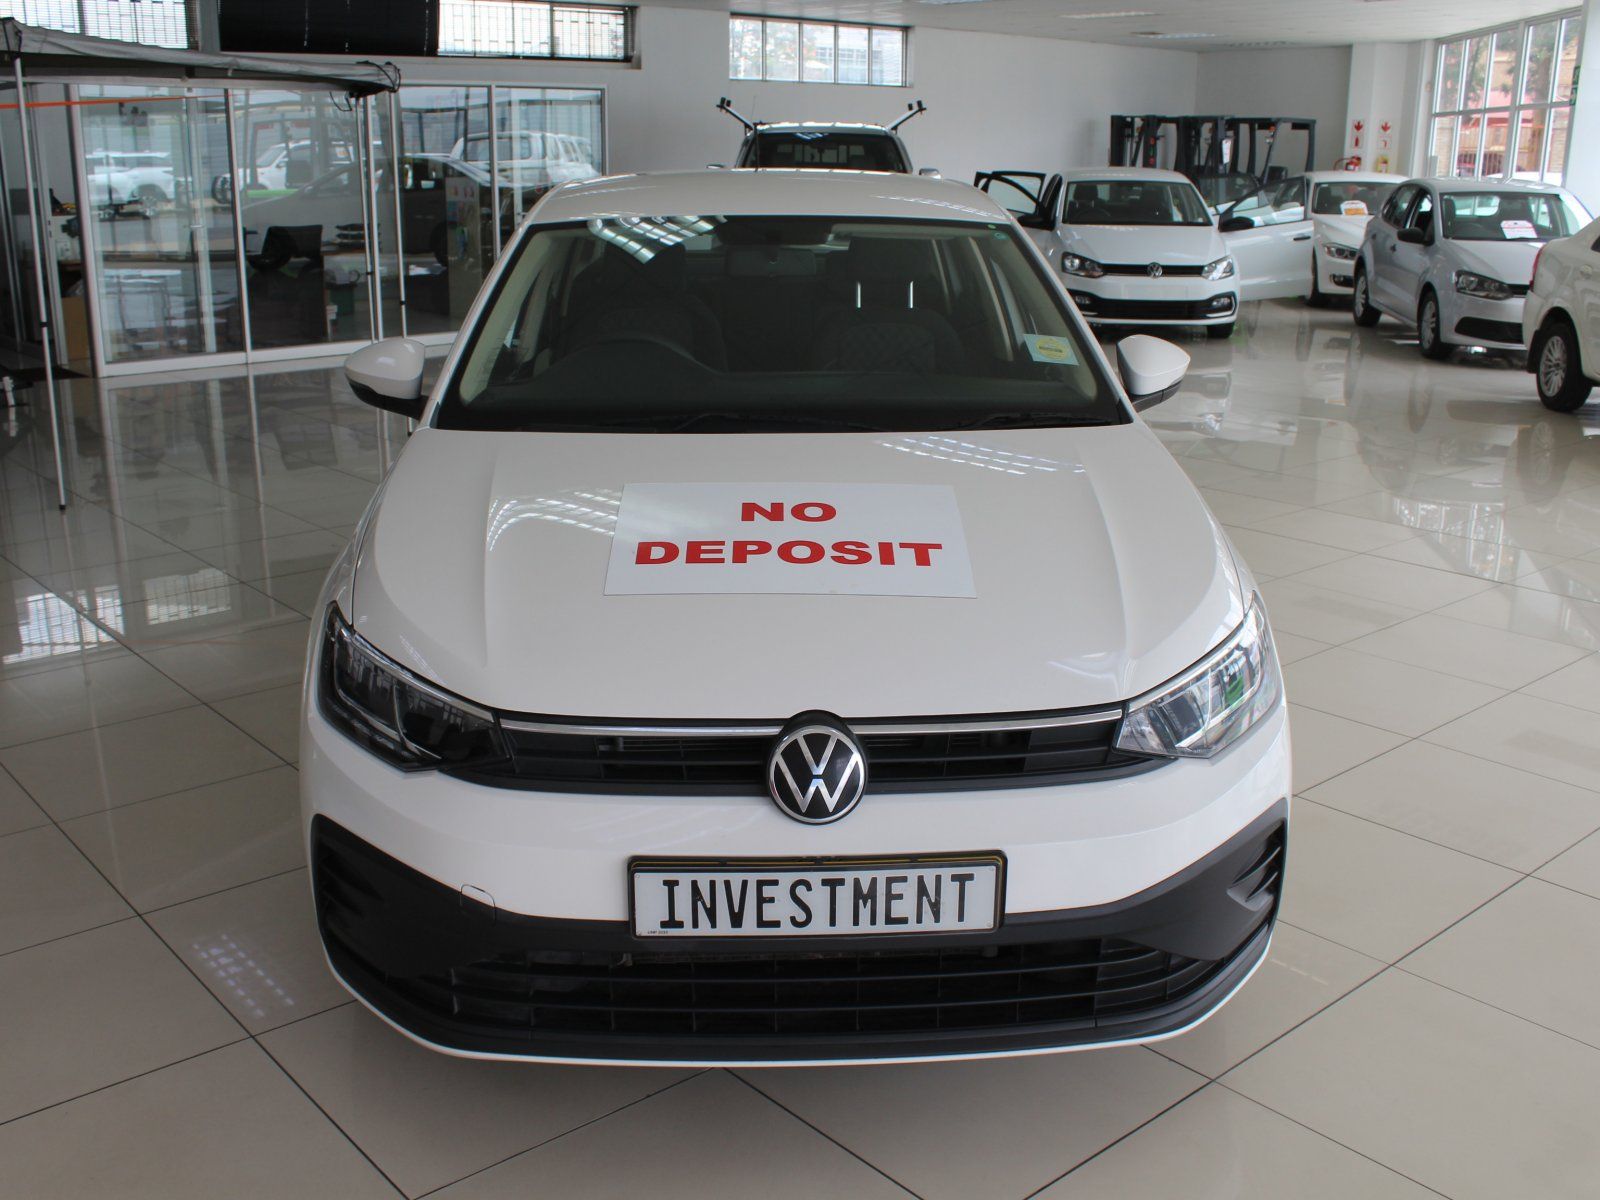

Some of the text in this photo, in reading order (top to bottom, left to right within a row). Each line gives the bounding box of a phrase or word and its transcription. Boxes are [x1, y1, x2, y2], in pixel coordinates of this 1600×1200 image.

[741, 502, 837, 522] NO
[635, 540, 943, 567] DEPOSIT
[770, 727, 864, 821] VW
[659, 873, 975, 930] INVESTMENT
